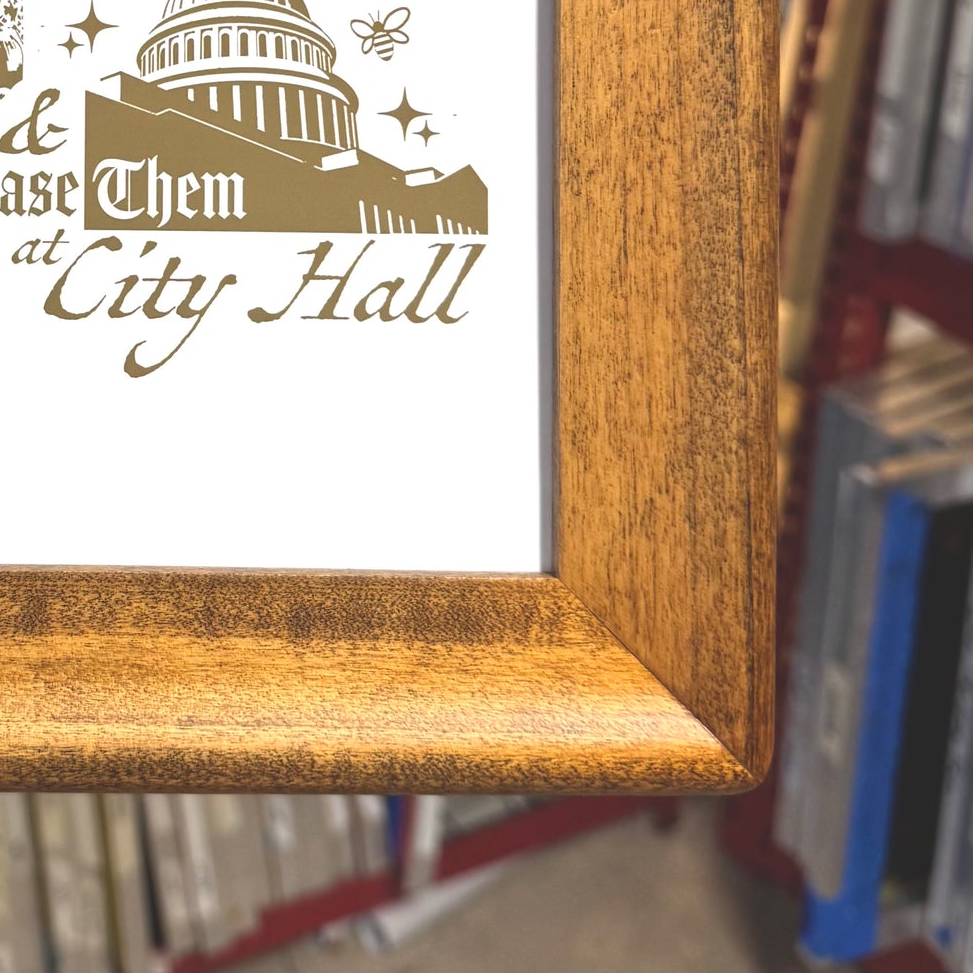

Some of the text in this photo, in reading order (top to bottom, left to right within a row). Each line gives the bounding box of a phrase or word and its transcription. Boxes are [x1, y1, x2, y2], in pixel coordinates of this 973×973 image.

[92, 154, 248, 228] Them
[11, 229, 487, 379] at City Hall
